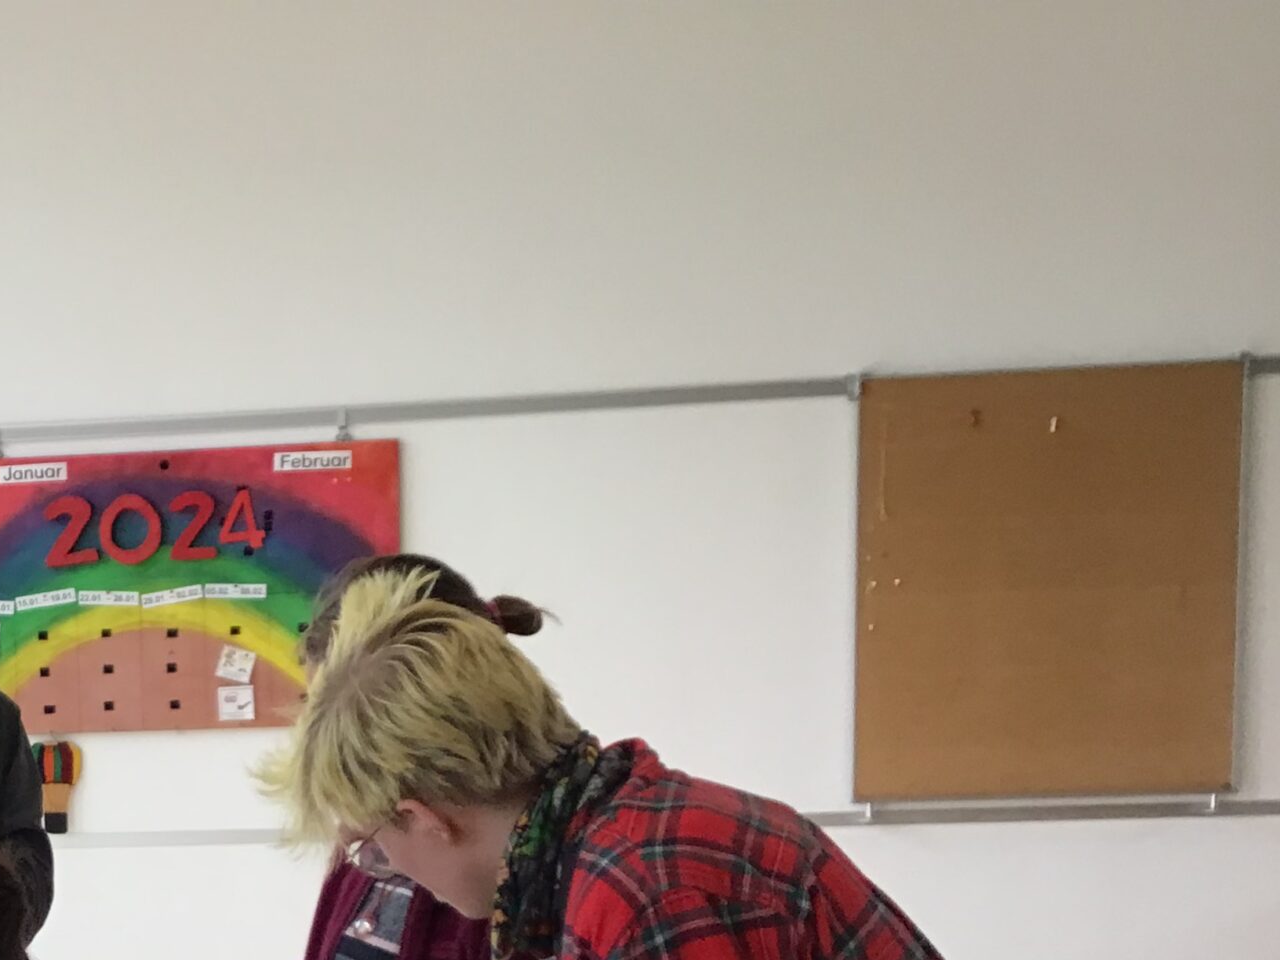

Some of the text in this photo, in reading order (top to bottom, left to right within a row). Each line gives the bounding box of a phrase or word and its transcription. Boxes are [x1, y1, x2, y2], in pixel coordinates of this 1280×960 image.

[280, 453, 350, 469] Februar
[3, 467, 63, 481] Januar
[43, 489, 266, 568] 2024
